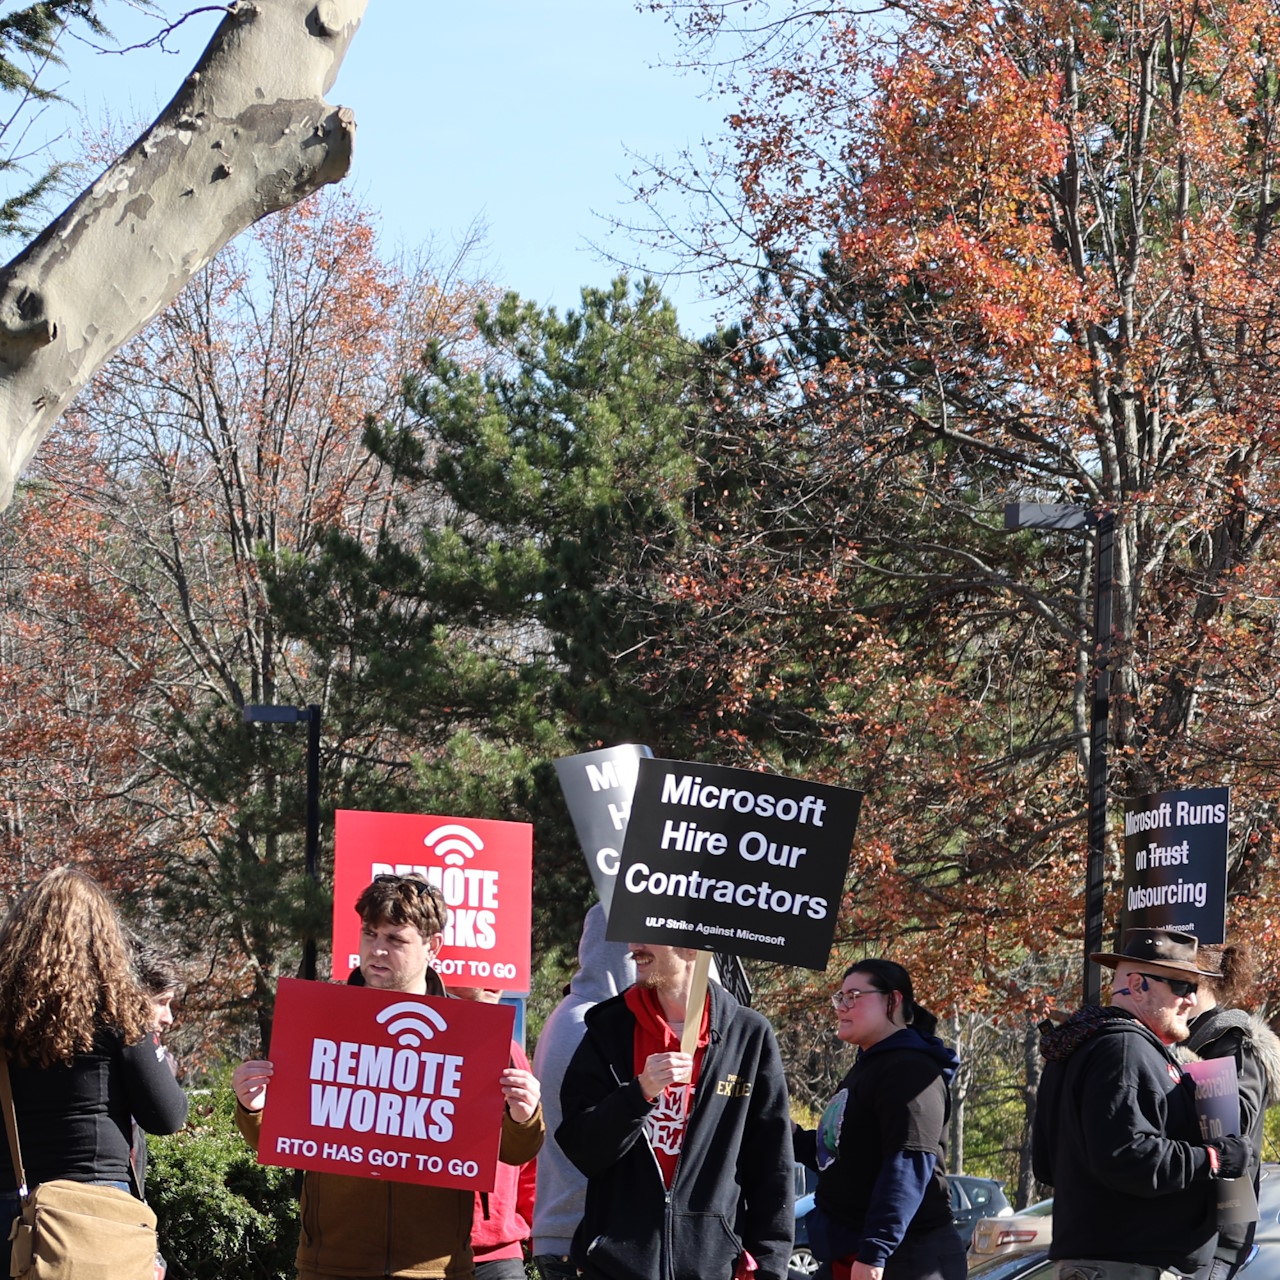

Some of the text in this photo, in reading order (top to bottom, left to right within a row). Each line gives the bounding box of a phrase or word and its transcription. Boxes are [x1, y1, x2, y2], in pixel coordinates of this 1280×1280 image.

[660, 773, 827, 827] Microsoft
[1125, 800, 1225, 837] Microsoft Runs
[660, 819, 807, 869] Hire Our
[1135, 840, 1189, 871] on Trust
[625, 862, 828, 920] Contractors
[1127, 878, 1207, 912] Outsourcing
[645, 916, 785, 946] ULP Strike Against Microsoft
[468, 961, 490, 976] TO
[493, 963, 516, 979] GO
[309, 1037, 464, 1098] REMOTE
[310, 1083, 455, 1142] WORKS
[276, 1136, 479, 1177] RTO HAS GOT TO GO
